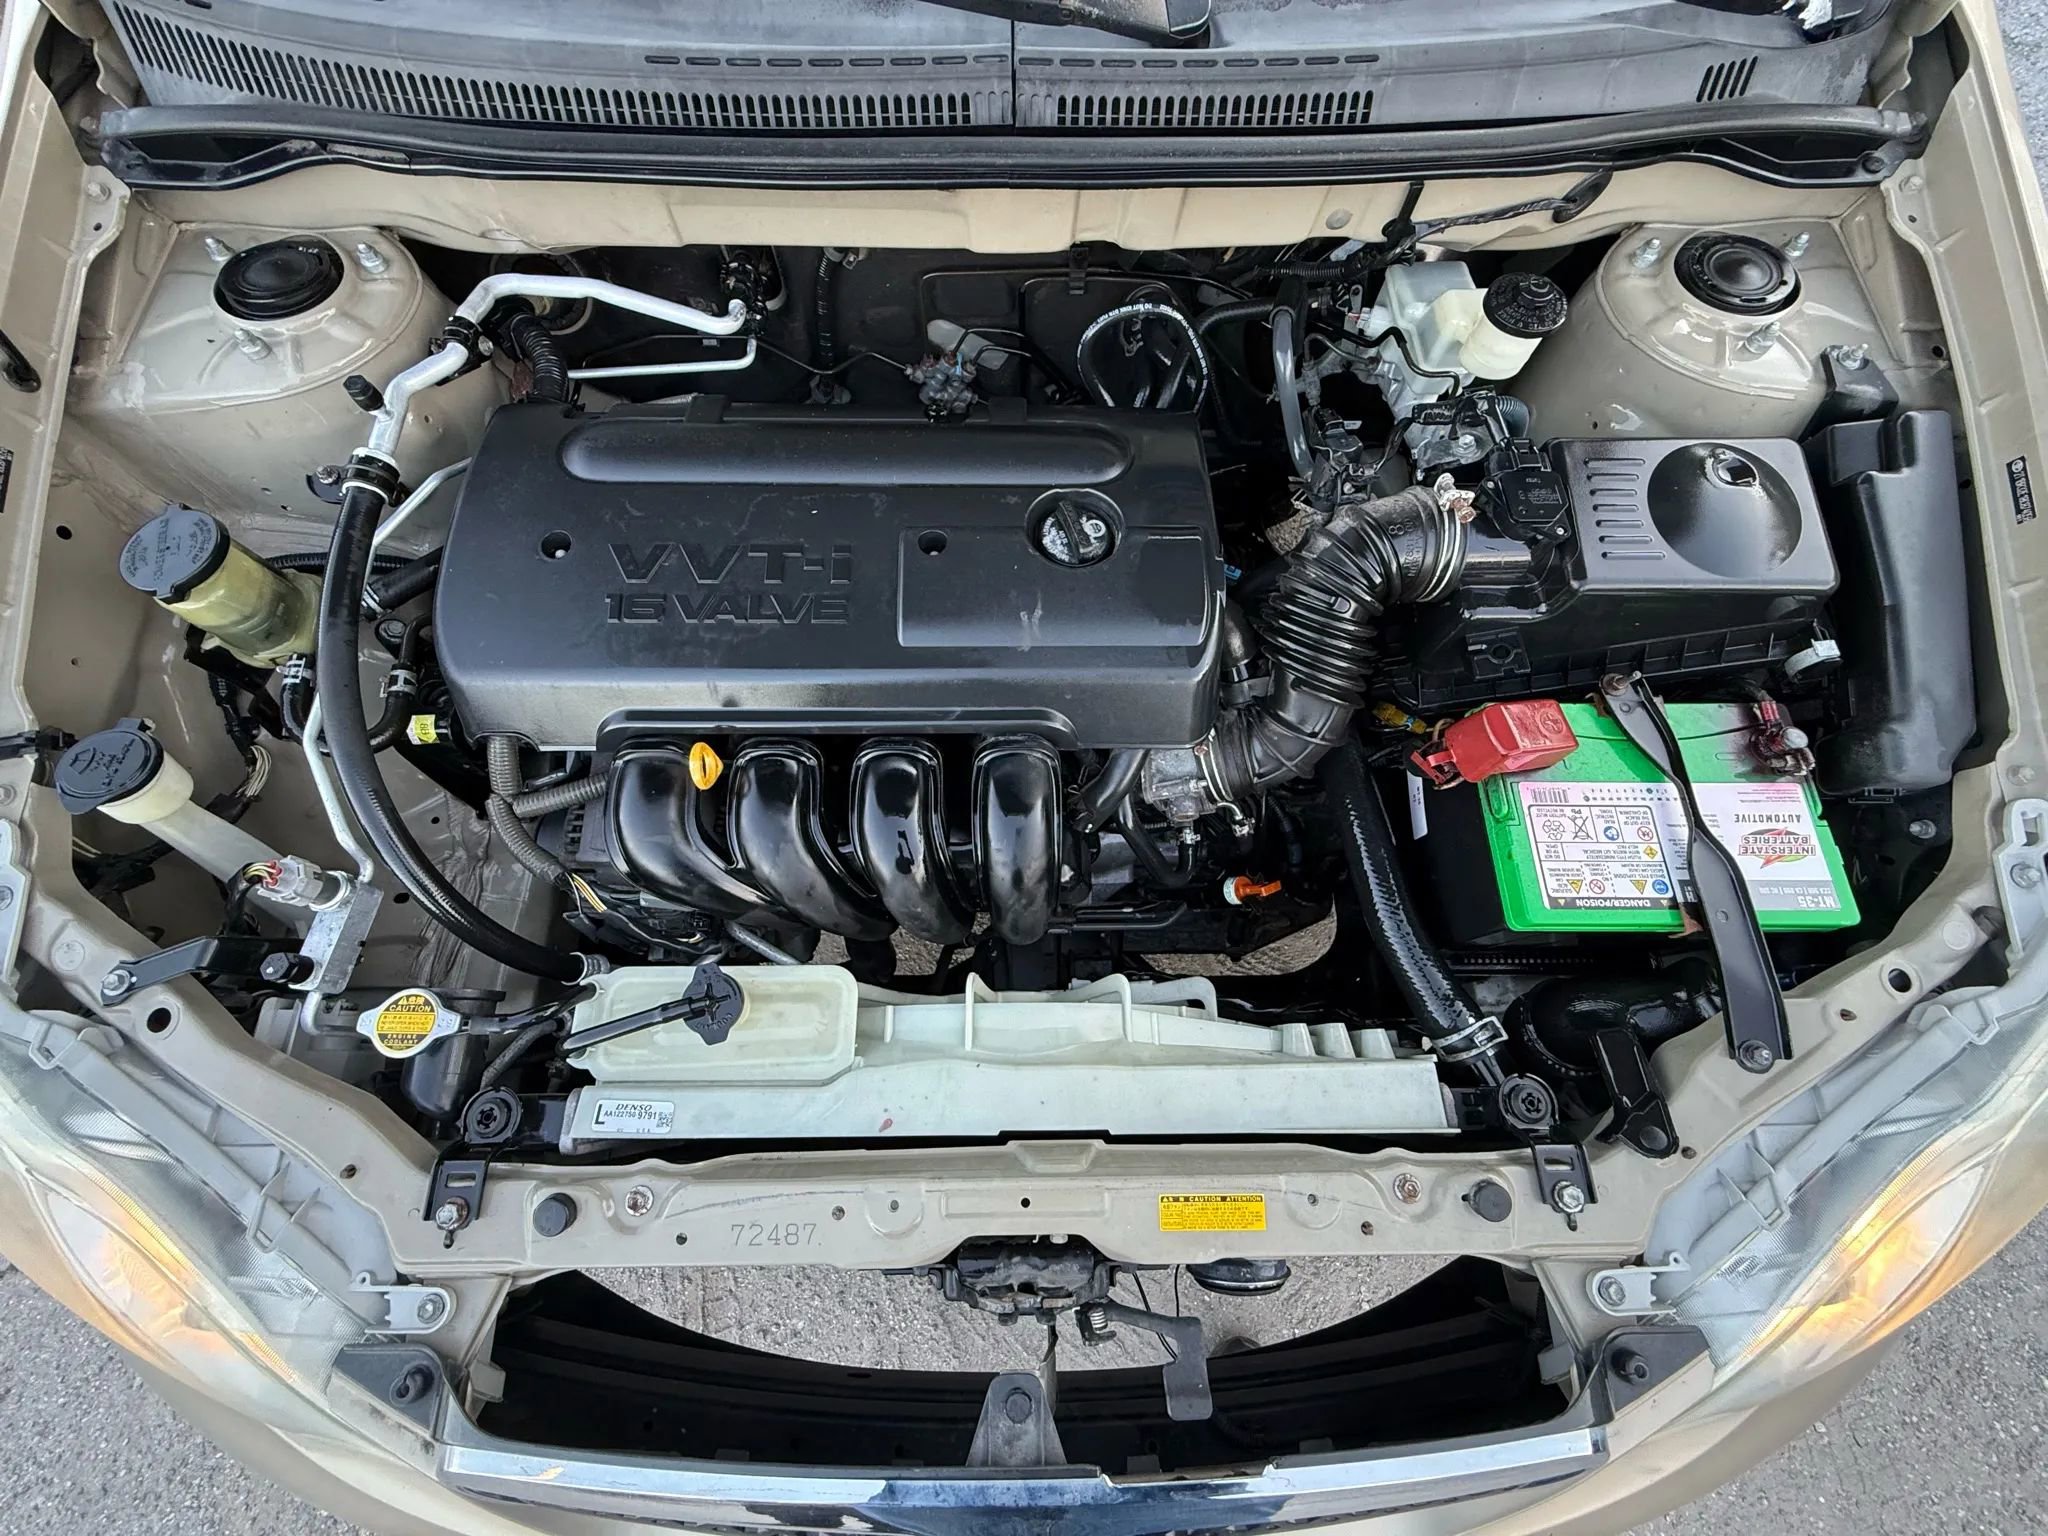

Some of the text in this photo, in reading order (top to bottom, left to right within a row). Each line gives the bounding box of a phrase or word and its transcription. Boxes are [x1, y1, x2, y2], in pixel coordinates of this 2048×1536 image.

[604, 592, 849, 624] 16 VALVE
[1734, 814, 1801, 822] AUTOMOTIVE
[1576, 898, 1650, 907] DANGER/POISON
[1798, 896, 1835, 907] MT-35
[389, 1004, 432, 1012] CAUTION
[616, 1103, 653, 1111] DENSO
[594, 1103, 605, 1125] L
[637, 1111, 657, 1120] 9791
